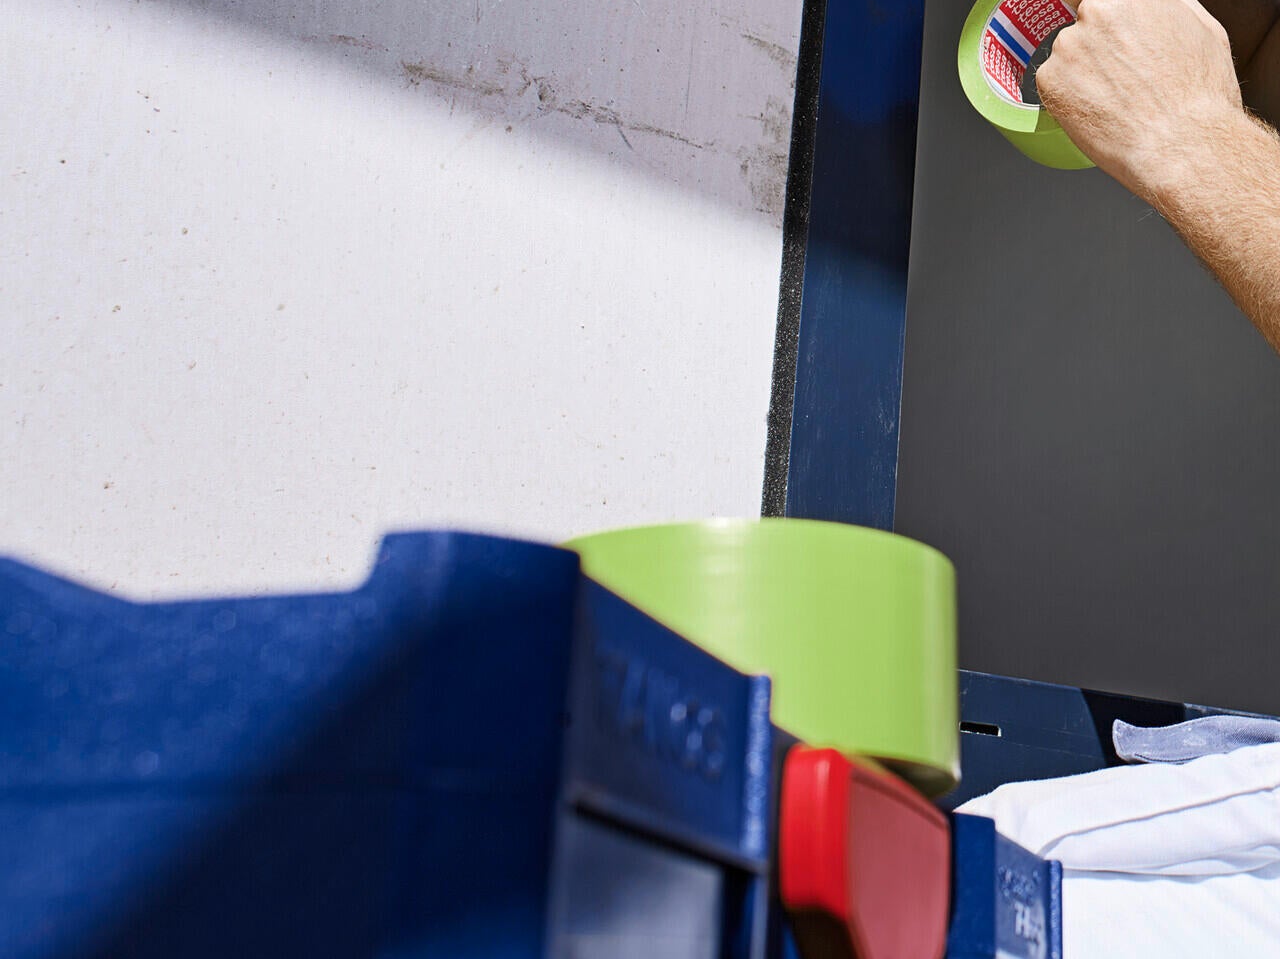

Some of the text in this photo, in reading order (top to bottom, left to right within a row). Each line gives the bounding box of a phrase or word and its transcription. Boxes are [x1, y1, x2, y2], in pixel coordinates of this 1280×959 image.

[1023, 3, 1055, 29] tesa
[1029, 10, 1061, 35] tesa
[1035, 17, 1066, 42] tesa
